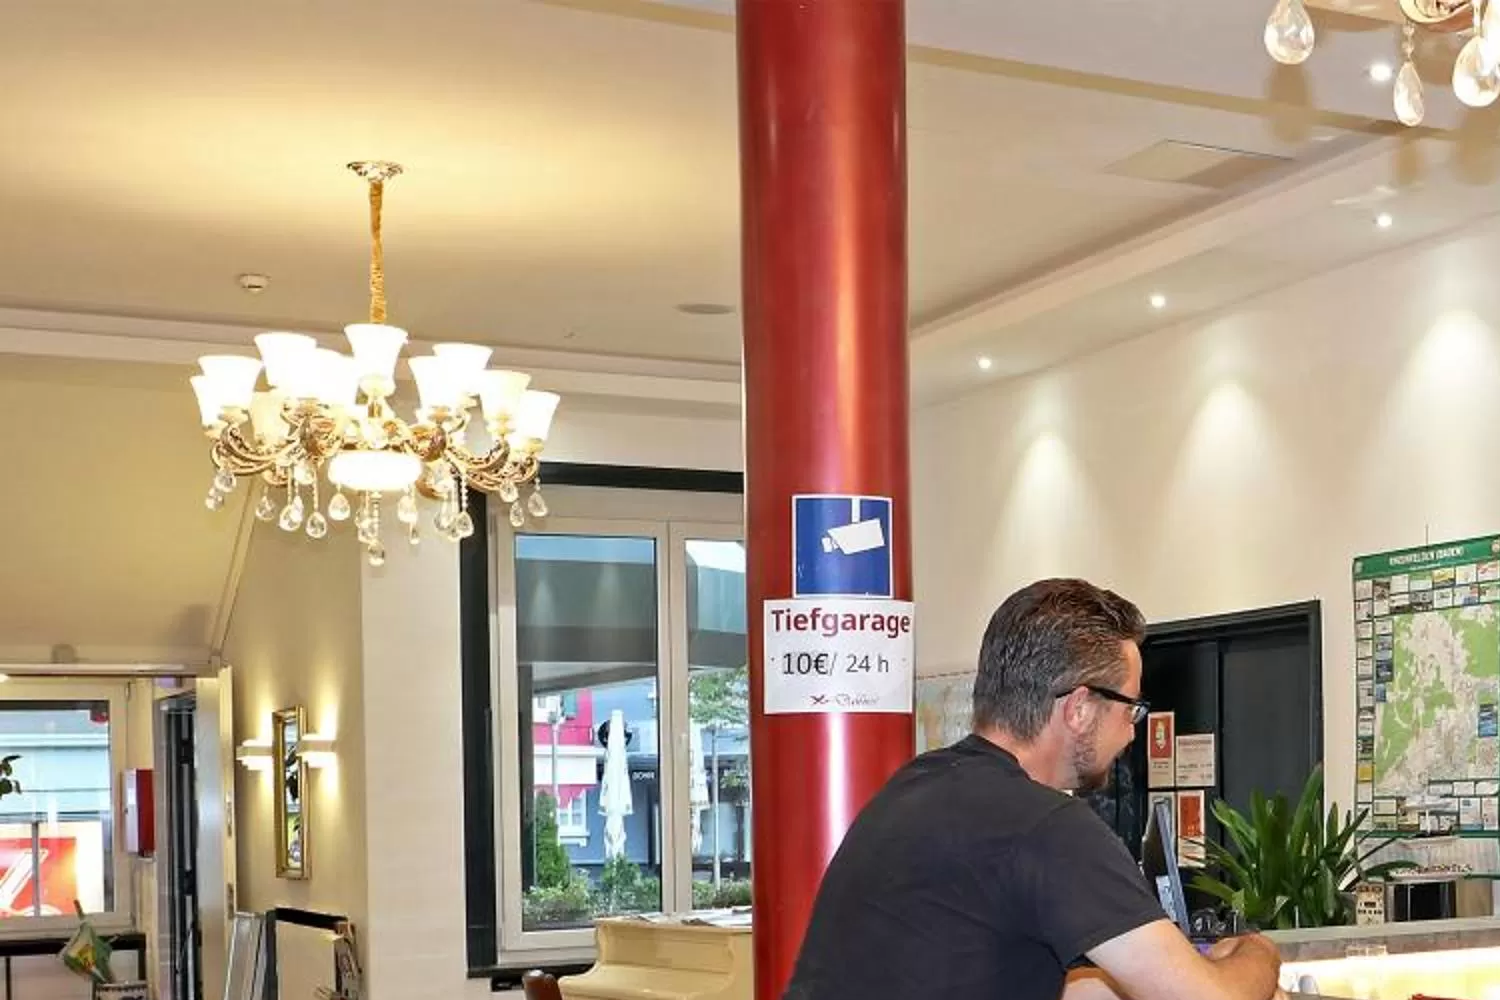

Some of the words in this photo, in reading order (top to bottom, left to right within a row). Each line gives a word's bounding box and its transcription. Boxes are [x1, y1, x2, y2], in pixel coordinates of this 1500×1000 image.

[771, 607, 911, 638] Tiefgarage
[846, 653, 872, 673] 24
[877, 653, 890, 673] h
